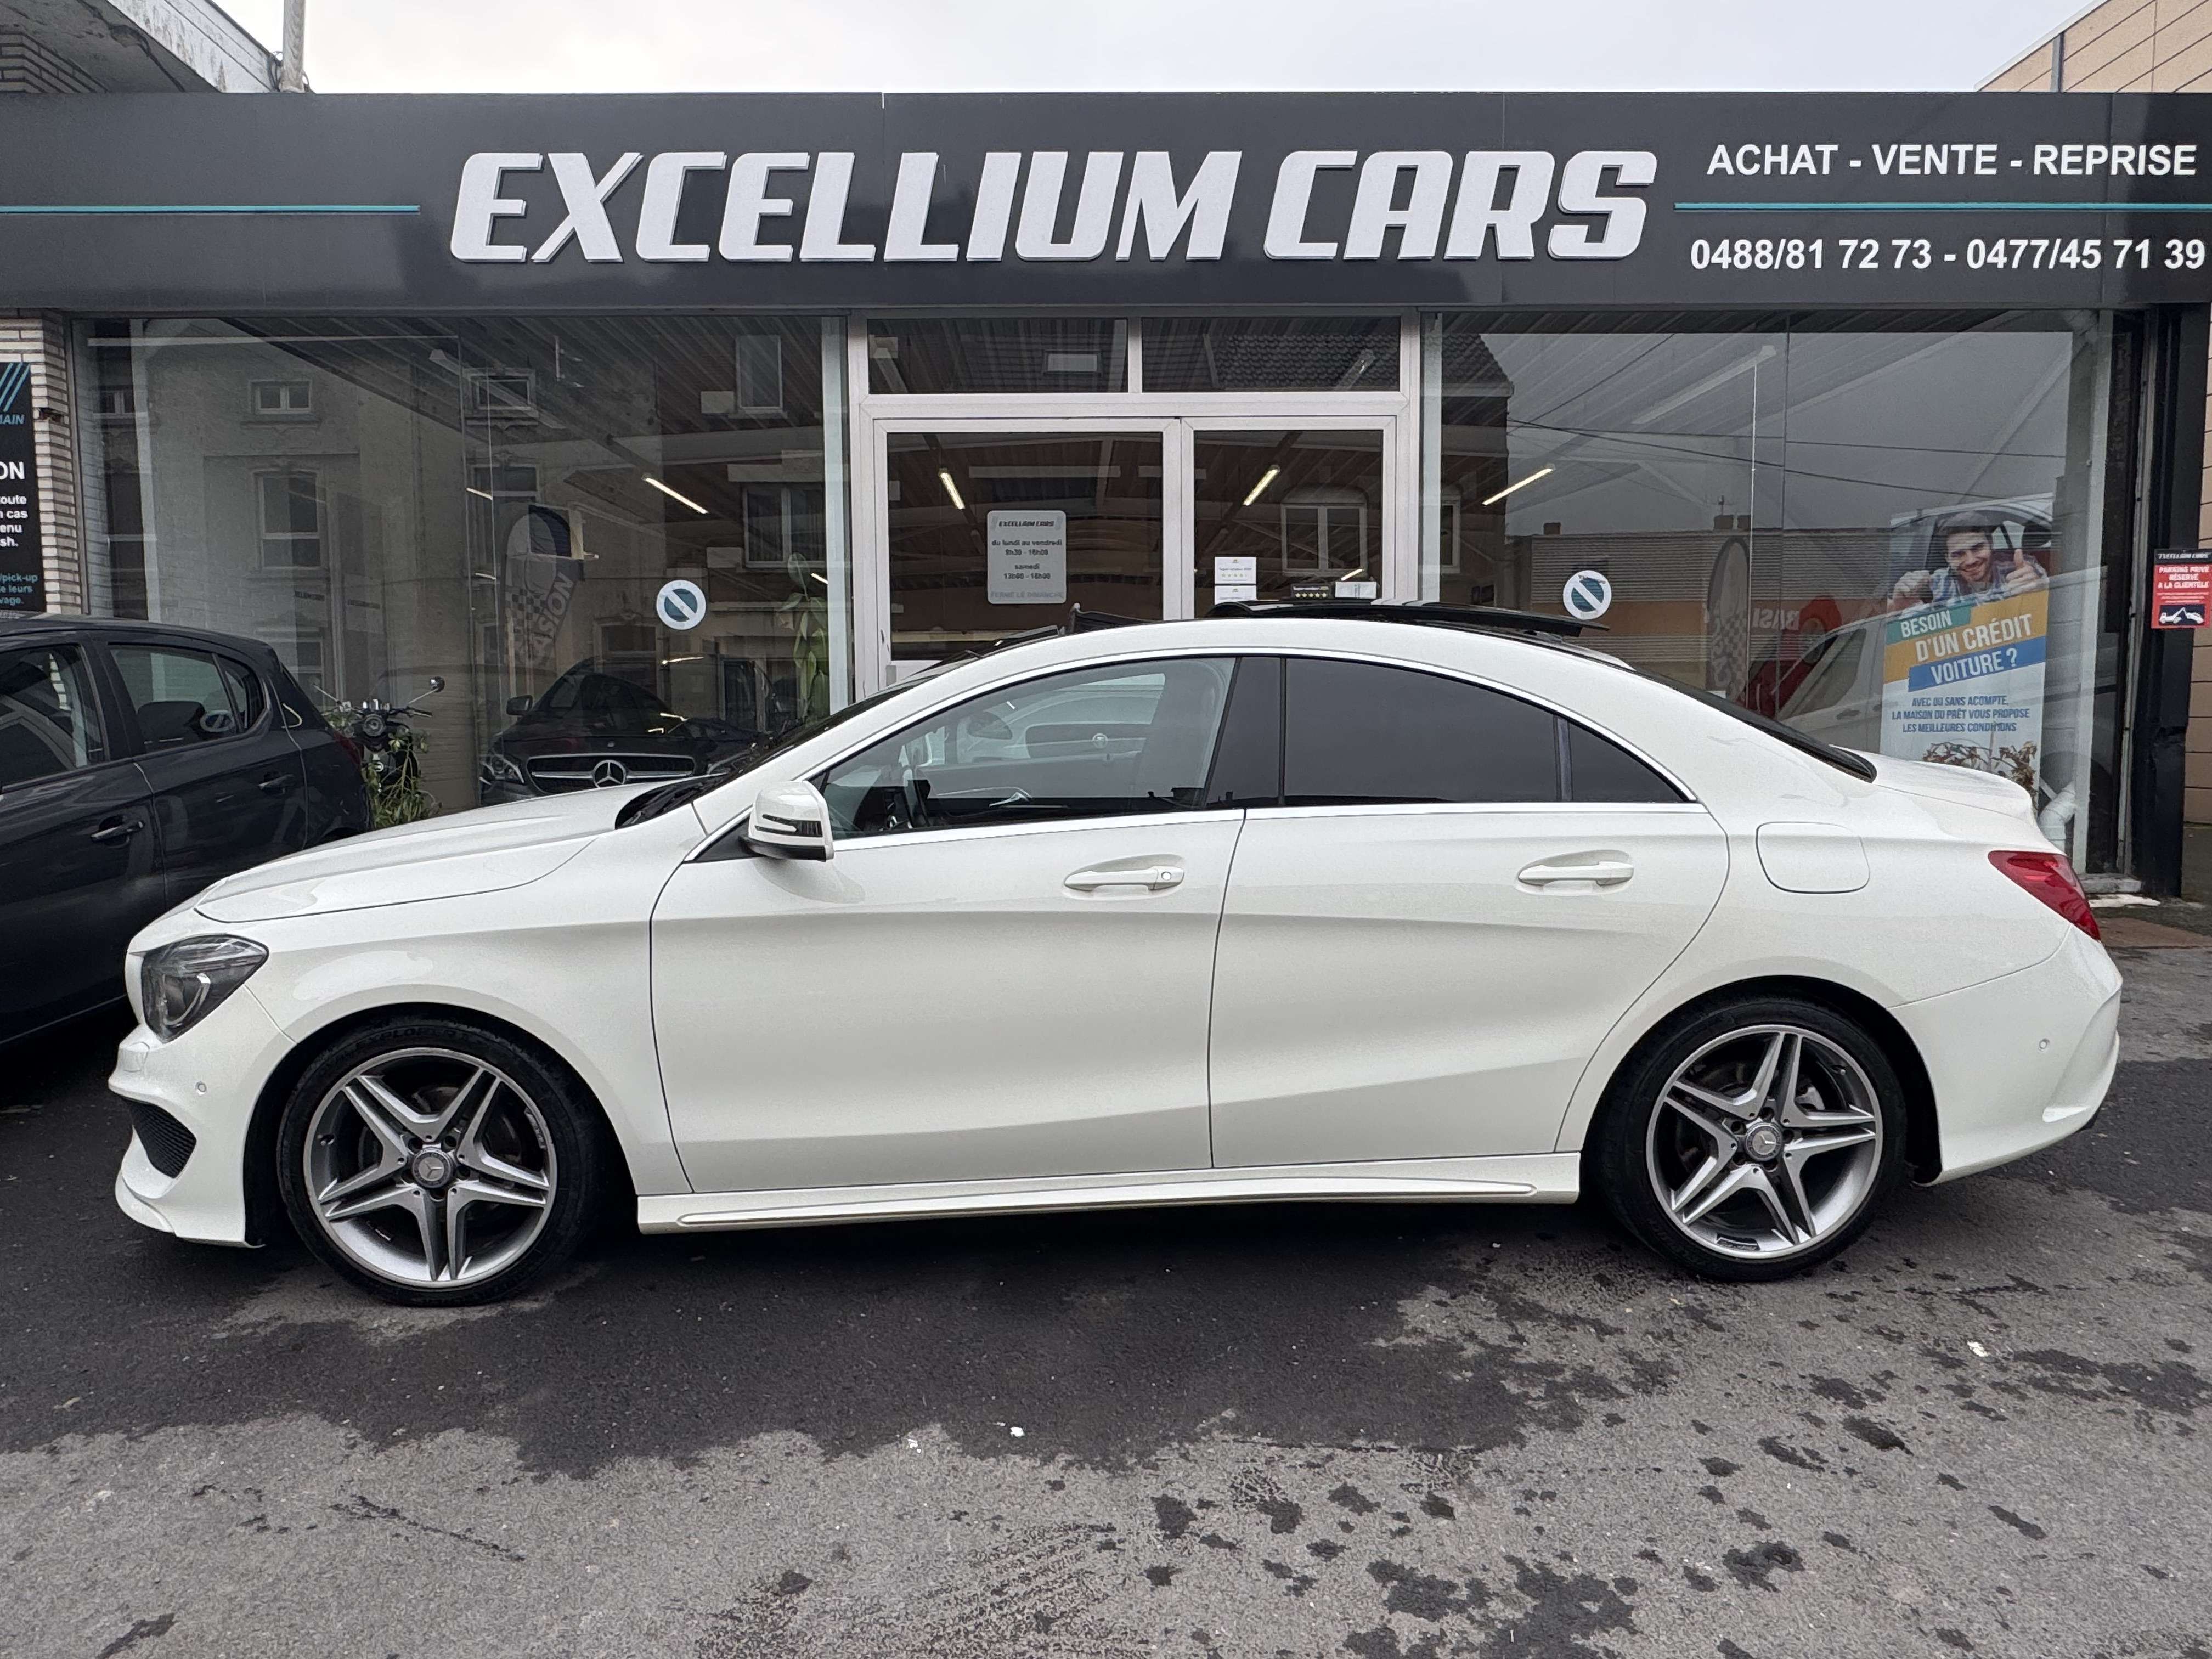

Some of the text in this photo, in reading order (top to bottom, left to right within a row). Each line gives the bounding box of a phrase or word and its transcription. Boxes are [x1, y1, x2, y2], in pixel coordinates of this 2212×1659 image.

[1706, 144, 1839, 175] ACHAT
[1872, 144, 1999, 175] VENTE
[2033, 144, 2198, 176] REPRISE
[450, 150, 1657, 263] EXCELLIUM CARS
[1690, 238, 1824, 270] 0488/81
[1839, 239, 1880, 269] 72
[1891, 239, 1932, 269] 73
[1966, 239, 2102, 270] 0477/45
[2113, 239, 2151, 270] 71
[2164, 239, 2206, 270] 39
[7, 511, 28, 519] cas
[1900, 610, 1953, 637] BESOIN
[1915, 613, 2032, 662] D'UN CRÉDIT
[1931, 647, 2018, 684] VOITURE ?
[1892, 708, 2029, 720] LA MAISON DU PRÊT VOUS PROPOSE
[1911, 697, 1932, 707] AVEC
[1933, 697, 1943, 706] OU
[1945, 696, 1966, 706] SANS
[1903, 723, 1917, 733] LES
[1918, 723, 1965, 733] MEILLEURES
